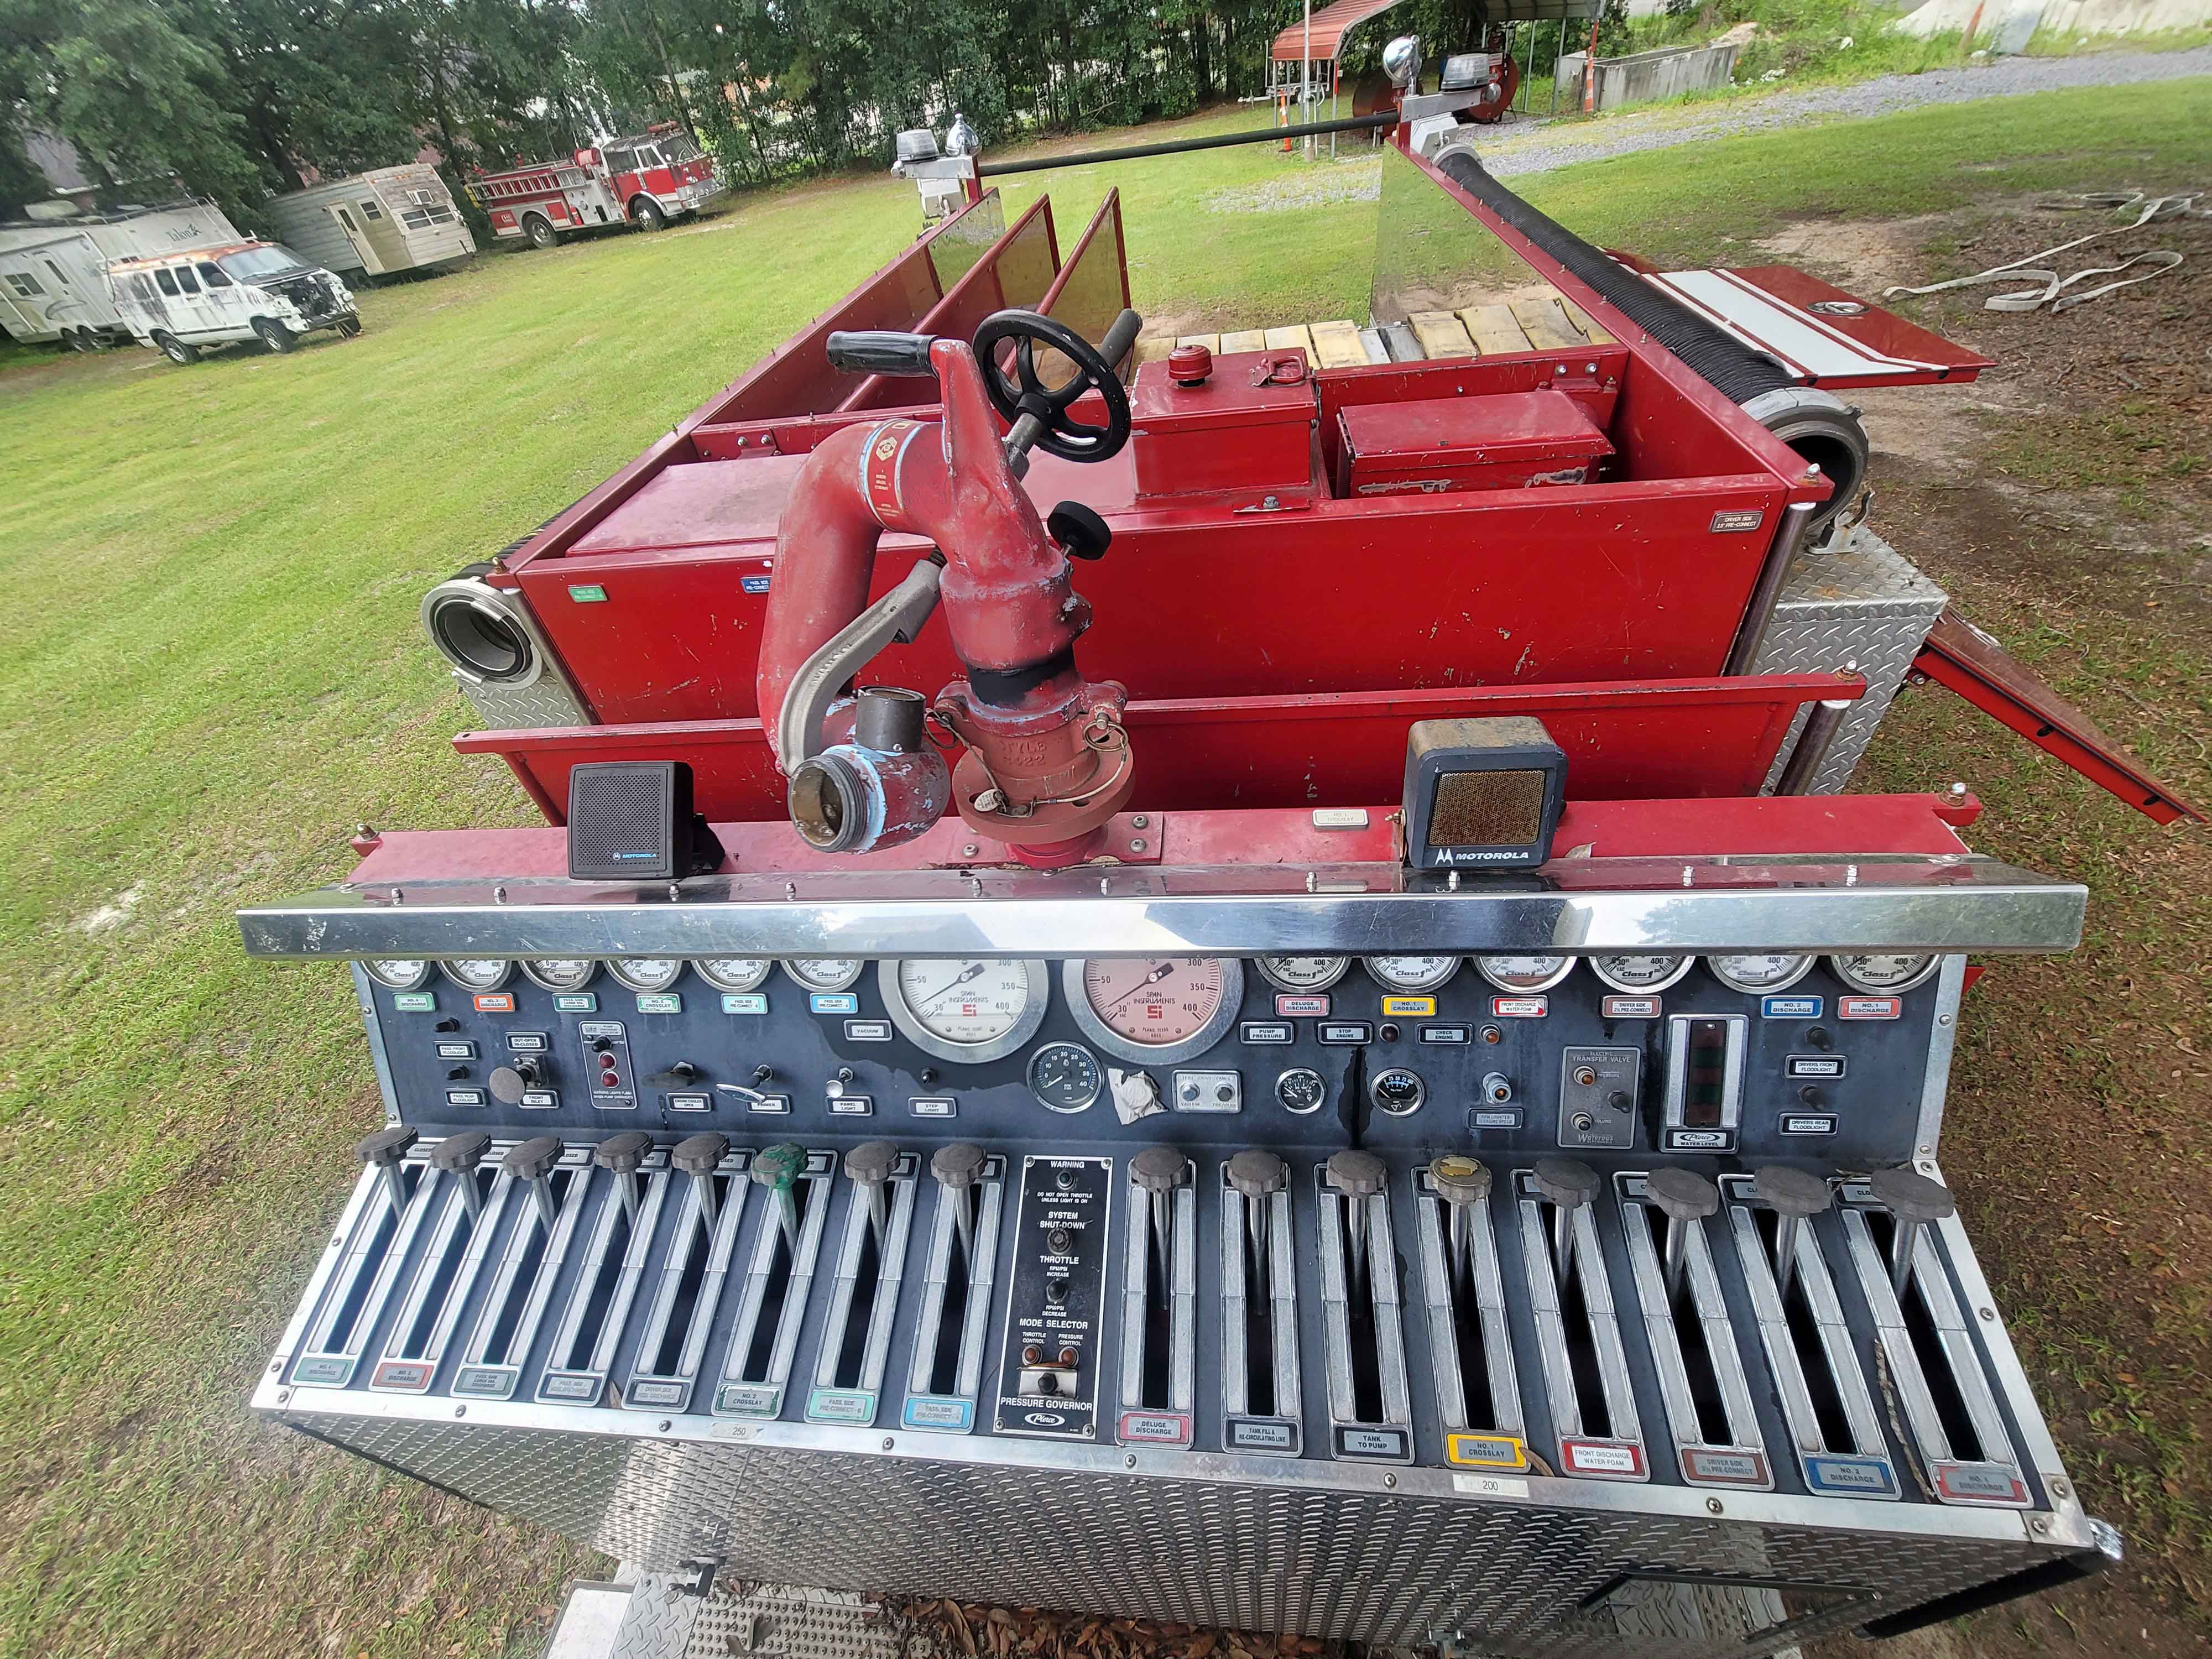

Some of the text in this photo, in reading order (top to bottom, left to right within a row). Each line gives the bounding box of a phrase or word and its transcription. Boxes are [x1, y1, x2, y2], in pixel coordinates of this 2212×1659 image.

[1455, 852, 1529, 860] MOTOROLA
[1050, 1160, 1085, 1168] WARNING
[1047, 1211, 1078, 1220] SYSTEM
[1039, 1220, 1085, 1230] SHUT-DOWN
[1039, 1255, 1079, 1265] THROTTLE
[1019, 1318, 1088, 1330] MODE SELECTOR
[1000, 1397, 1093, 1412] PRESSURE GOVERNOR
[1034, 1414, 1056, 1425] Pierce
[732, 1426, 746, 1436] 250
[1135, 1427, 1172, 1436] DISCHARGE
[1238, 1434, 1275, 1443] RE-CIRCULATING
[1468, 1448, 1505, 1458] CROSSLAY
[1574, 1449, 1631, 1461] FRONT DISCHARGE
[1839, 1467, 1860, 1476] NO. 2
[1829, 1473, 1875, 1484] DISCHARGE
[1968, 1475, 1983, 1483] NO.
[1482, 1480, 1499, 1491] 200
[1958, 1482, 2004, 1492] DISCHARGE
